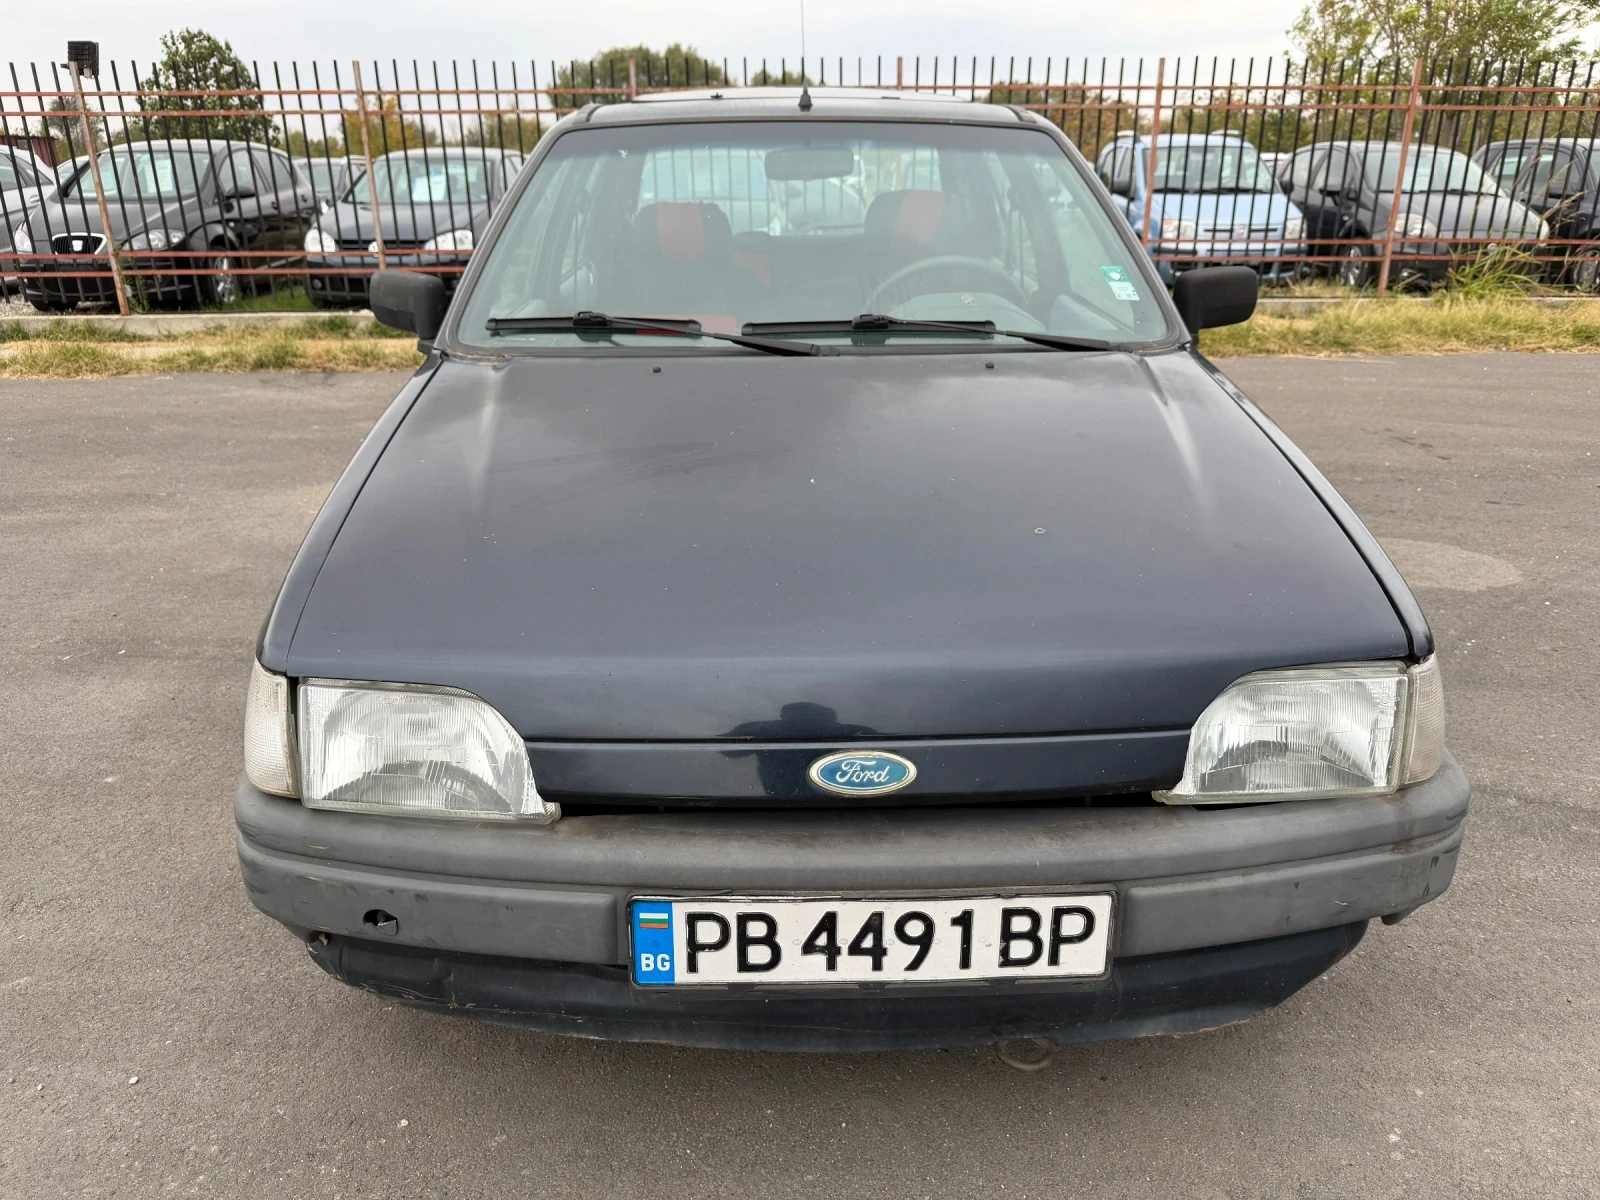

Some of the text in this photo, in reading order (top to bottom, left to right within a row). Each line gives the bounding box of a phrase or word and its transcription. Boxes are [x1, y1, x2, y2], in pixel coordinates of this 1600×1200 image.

[836, 760, 890, 782] Ford
[685, 905, 1096, 974] PB 4491 BP
[640, 953, 671, 972] BG
